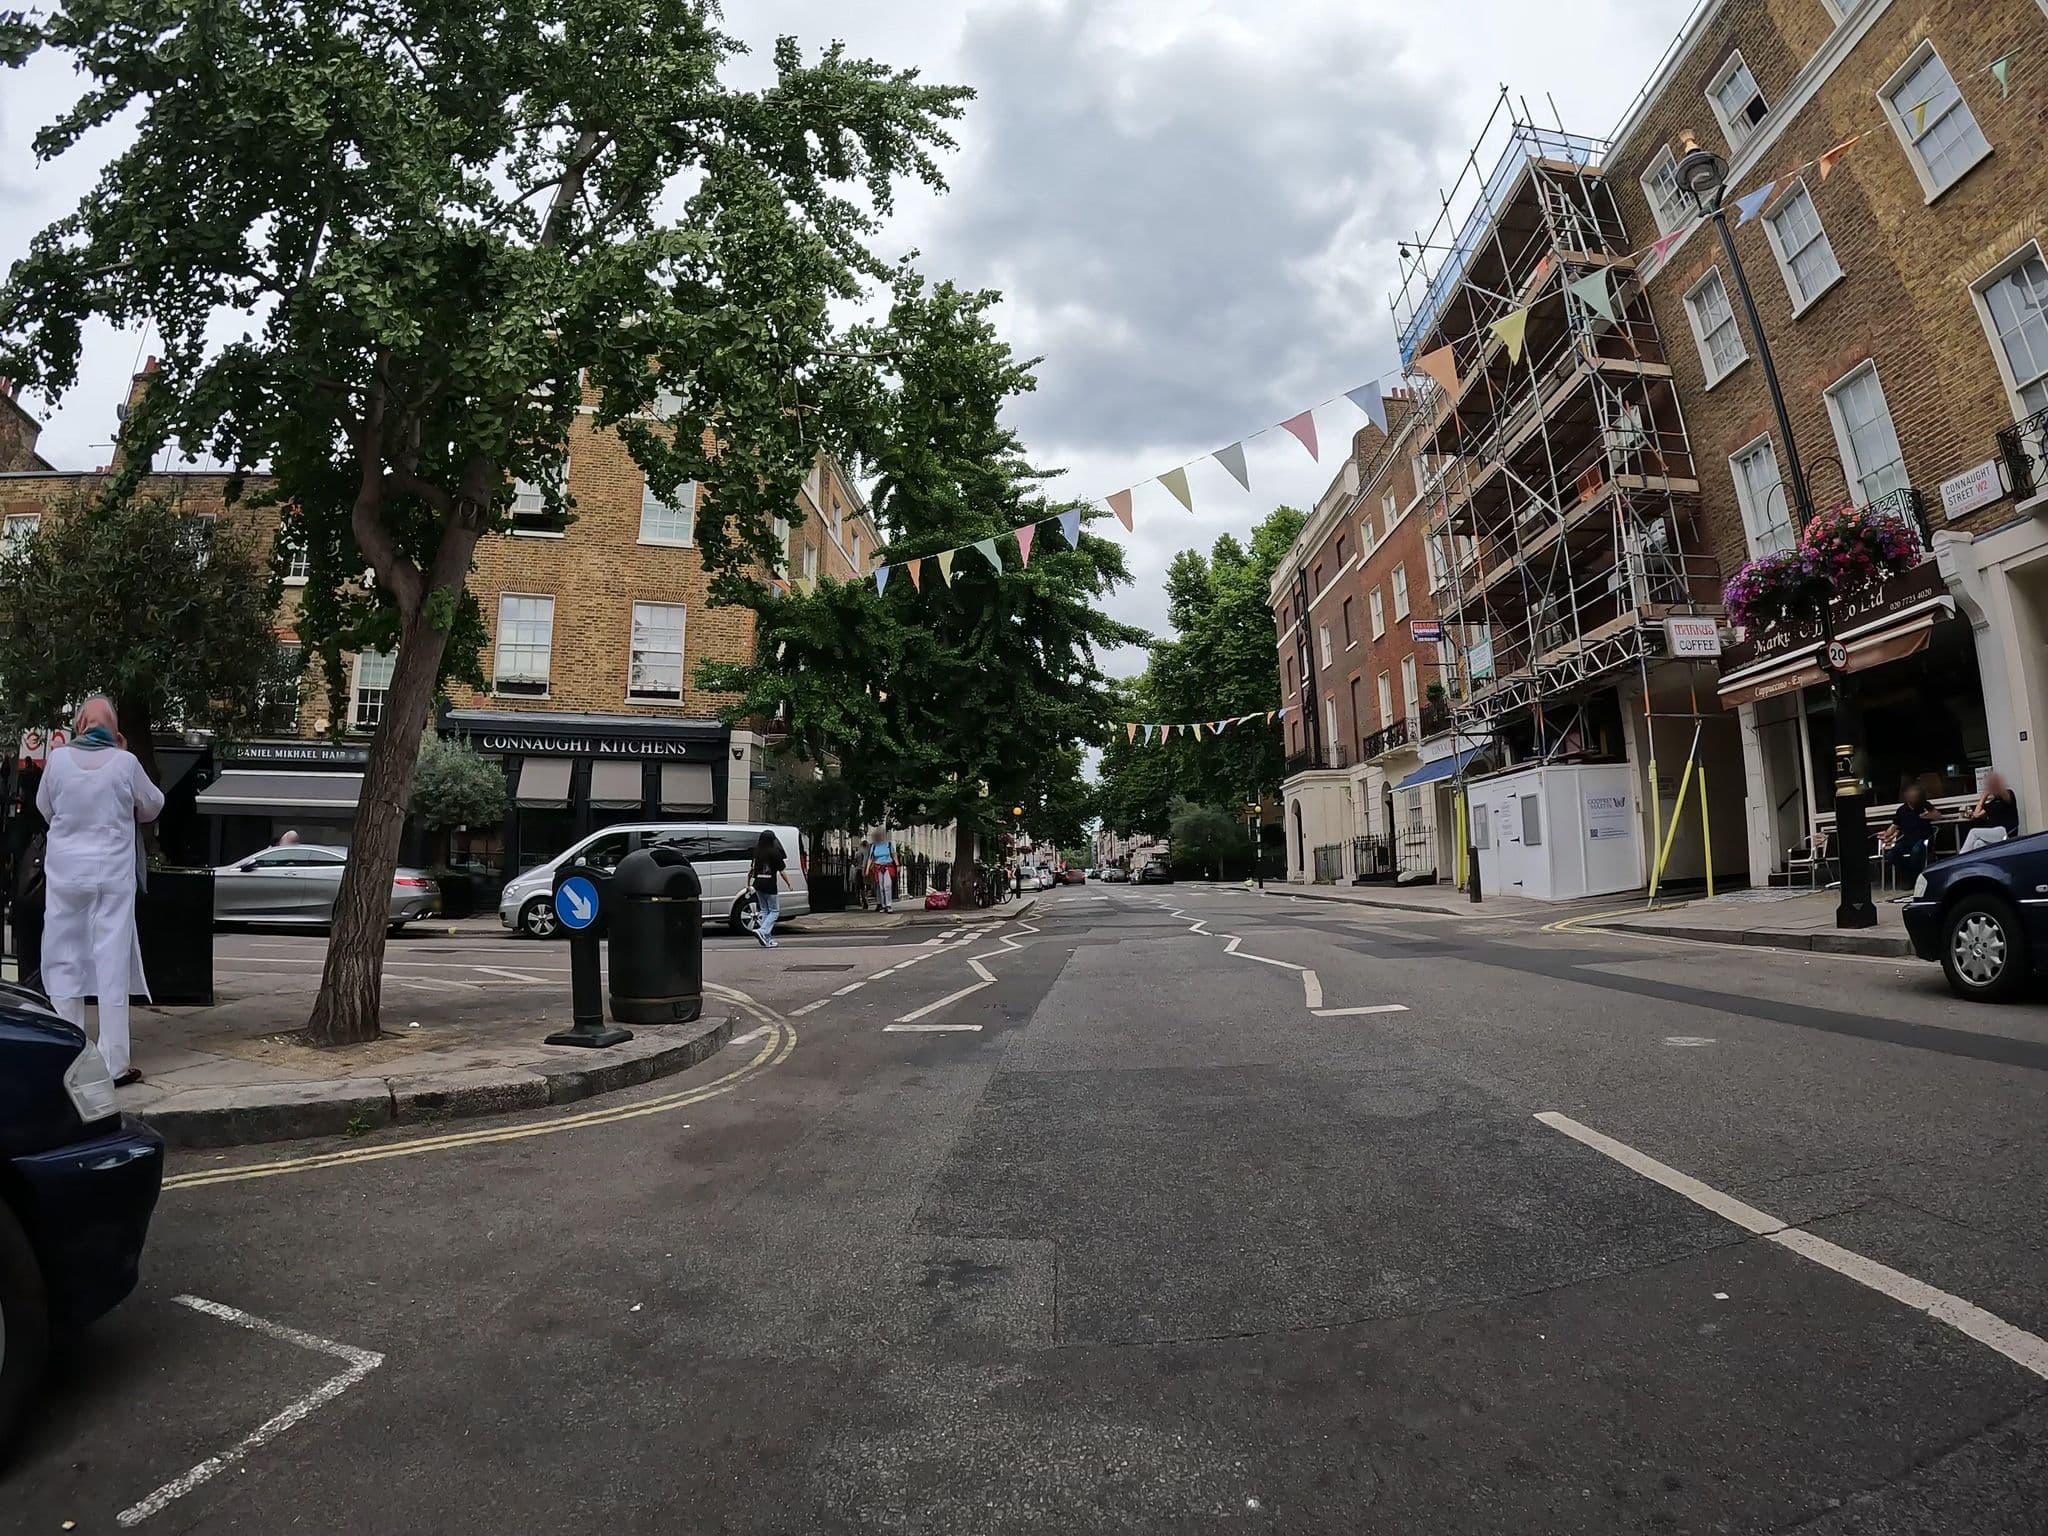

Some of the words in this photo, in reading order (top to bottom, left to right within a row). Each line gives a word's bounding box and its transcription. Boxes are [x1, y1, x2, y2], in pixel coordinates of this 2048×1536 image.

[1945, 466, 1991, 496] CONNAUGHT
[1948, 487, 1975, 506] STREET
[1975, 480, 1989, 493] W2
[1860, 584, 1885, 613] Ltd
[1679, 639, 1716, 651] COFFEE
[1830, 648, 1845, 661] 20
[237, 748, 272, 758] DANIEL
[275, 749, 317, 759] MIKHAEL
[322, 751, 346, 760] HAIR
[483, 735, 593, 752] CONNAUGHT
[599, 738, 686, 755] KITCHENS
